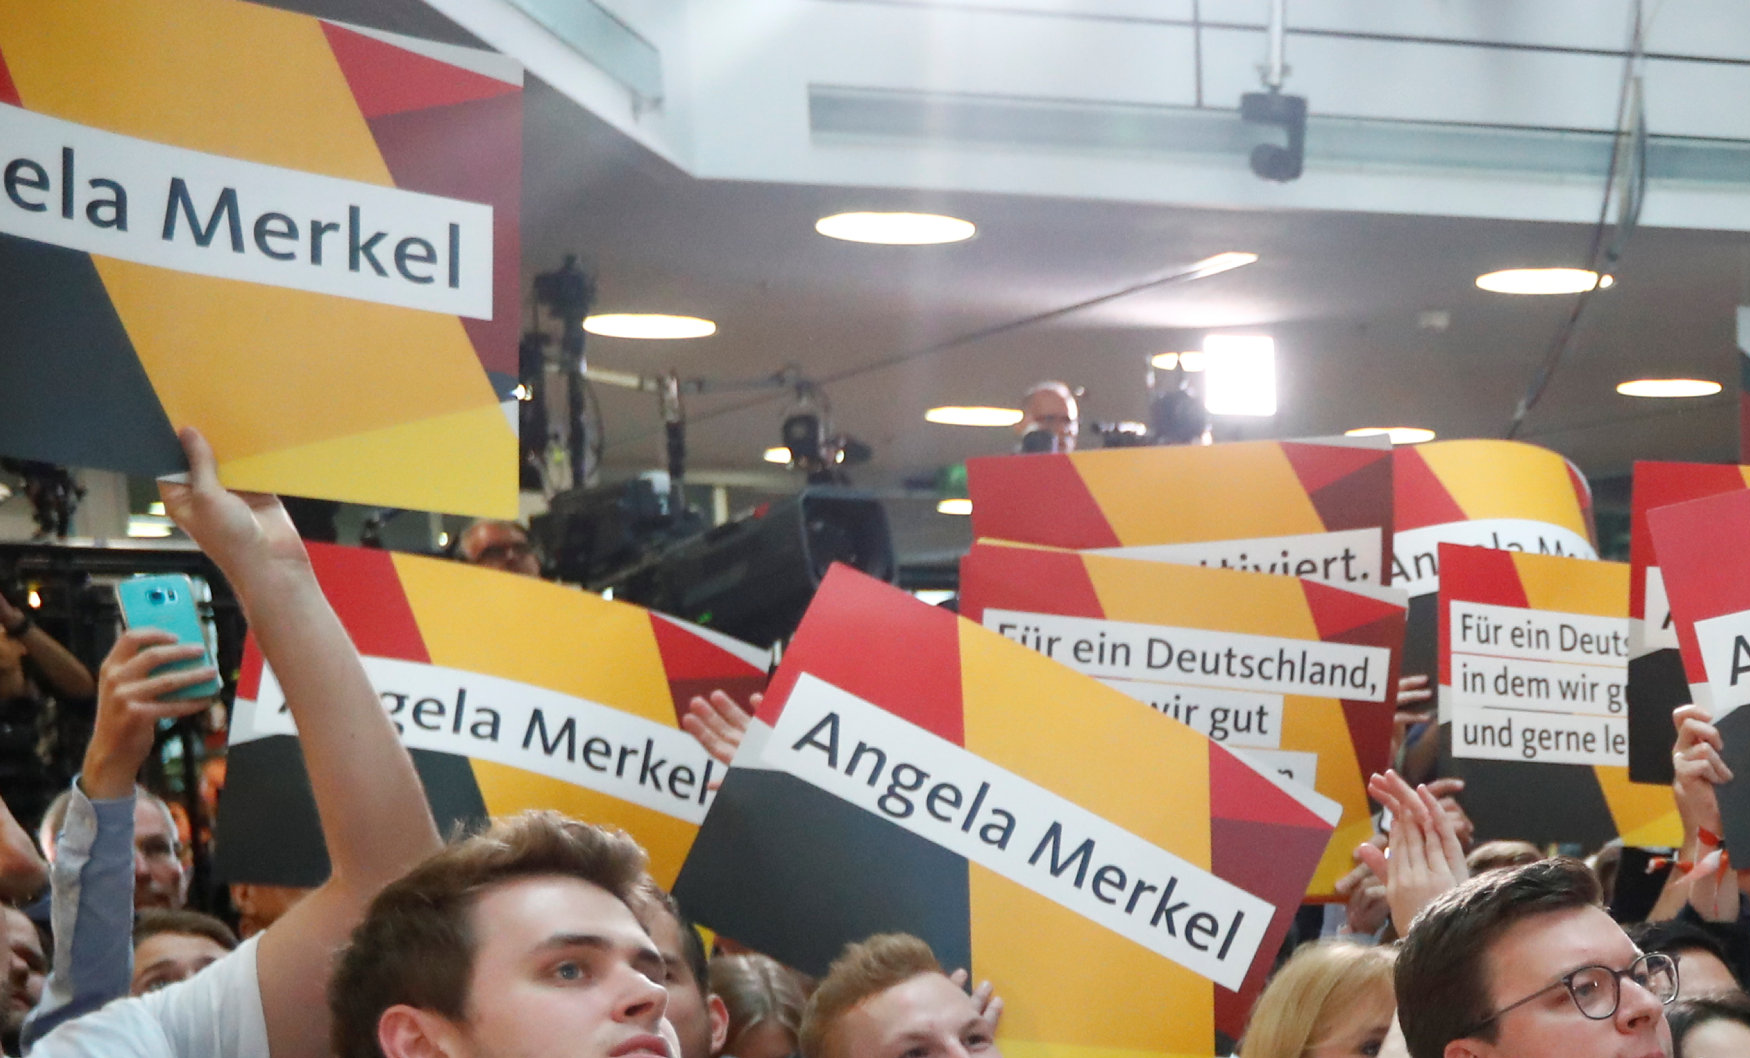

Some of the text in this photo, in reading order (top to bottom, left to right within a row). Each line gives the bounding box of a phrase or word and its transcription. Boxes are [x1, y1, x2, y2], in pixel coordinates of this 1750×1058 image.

[161, 176, 460, 289] Merkel
[1461, 614, 1503, 646] Für
[1511, 620, 1550, 650] ein
[1072, 631, 1131, 667] ein
[1146, 636, 1377, 696] Deutschland,
[1462, 663, 1485, 694] in
[1494, 666, 1550, 699] dem
[1558, 673, 1600, 703] wir
[1208, 703, 1269, 742] gut
[1463, 717, 1513, 747] und
[1521, 726, 1597, 758] gerne
[522, 708, 714, 804] Merkel
[792, 711, 1246, 961] Angela Merkel
